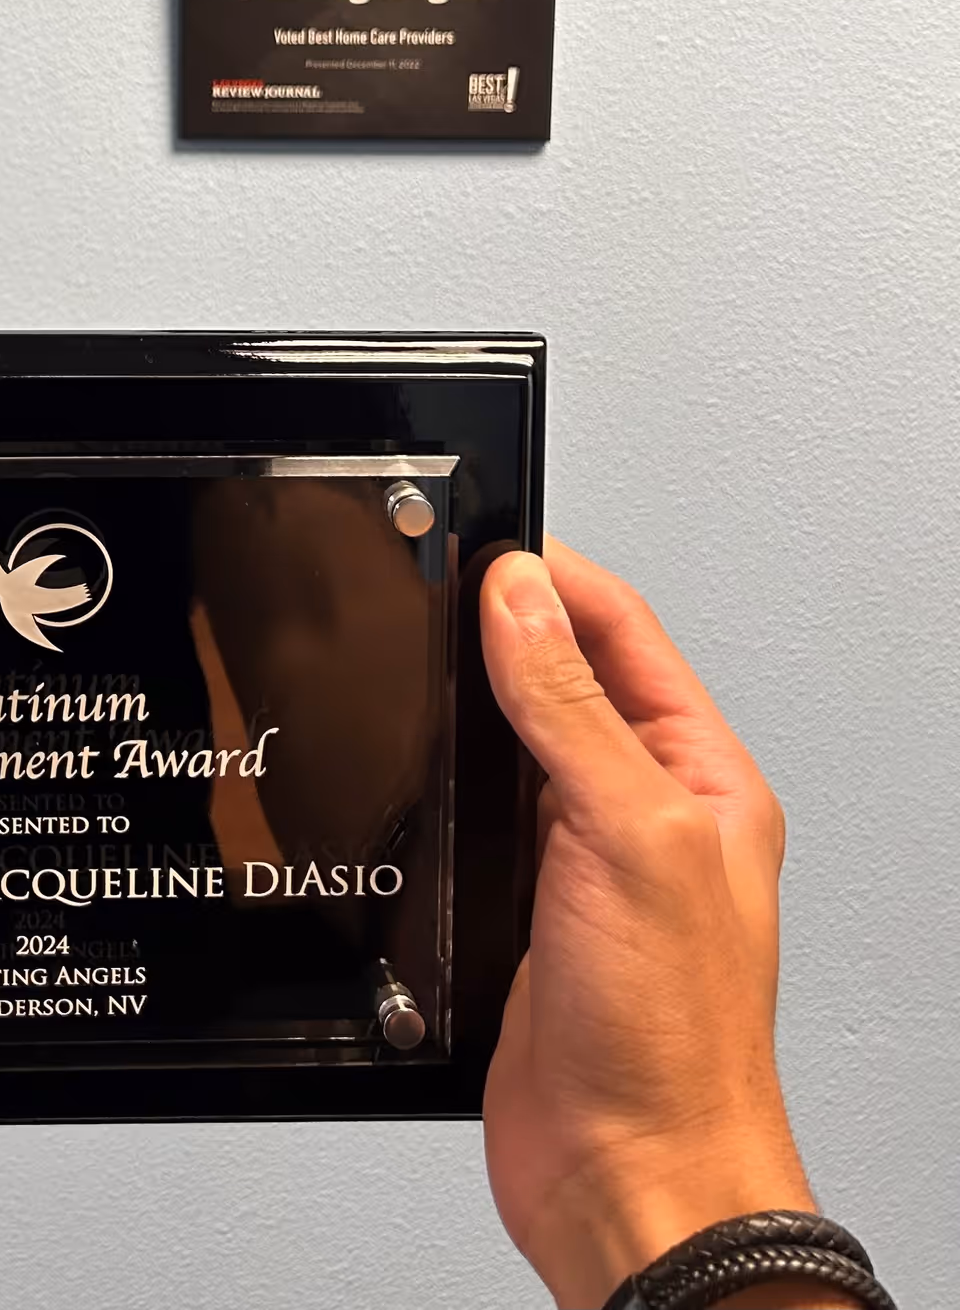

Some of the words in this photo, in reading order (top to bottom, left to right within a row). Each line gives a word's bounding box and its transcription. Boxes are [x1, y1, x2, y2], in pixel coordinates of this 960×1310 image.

[274, 27, 305, 45] Voted
[308, 27, 333, 45] Best
[335, 27, 368, 45] Home
[370, 27, 397, 45] Care
[399, 27, 456, 45] Providers
[469, 73, 502, 94] BEST
[114, 728, 279, 778] Award
[97, 816, 129, 833] TO
[16, 935, 69, 955] 2024
[108, 995, 147, 1014] NV
